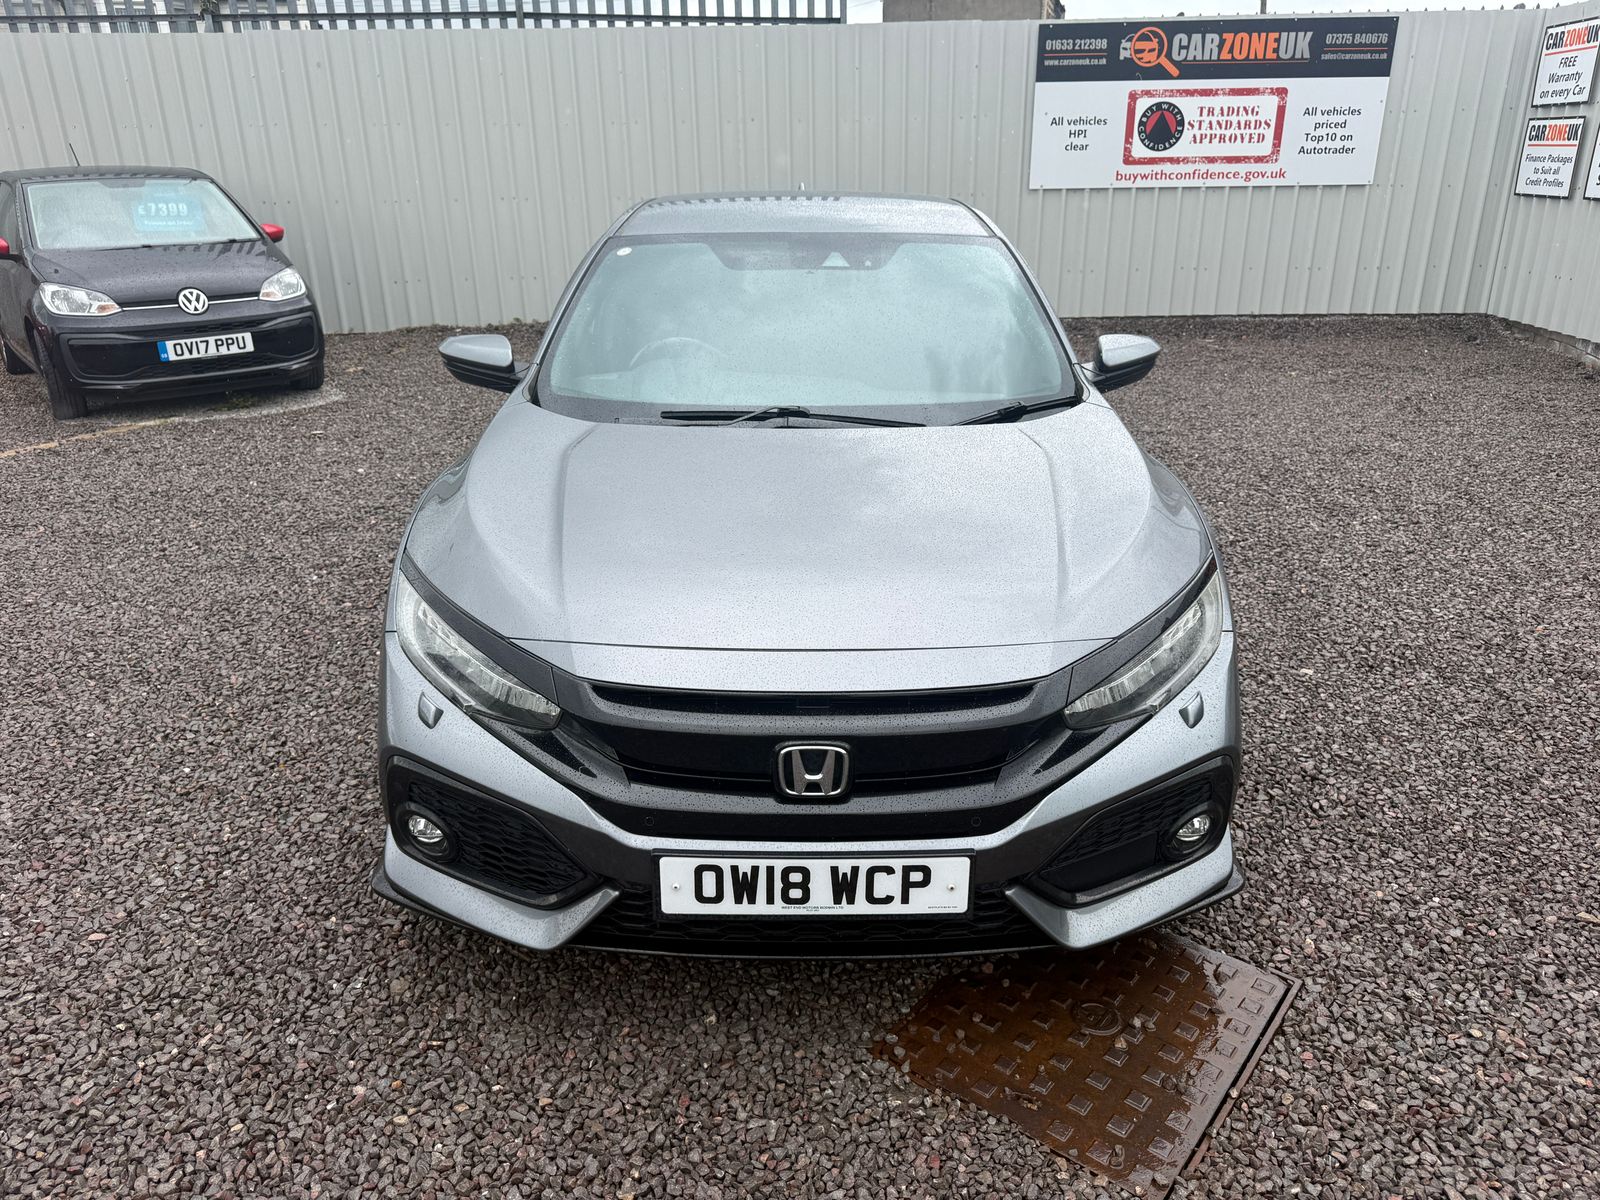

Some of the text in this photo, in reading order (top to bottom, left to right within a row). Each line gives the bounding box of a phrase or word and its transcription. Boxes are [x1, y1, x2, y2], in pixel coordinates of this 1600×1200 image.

[1325, 32, 1389, 45] 07375 840676
[1545, 23, 1600, 51] CARZONEUK
[1045, 38, 1108, 50] 01633 212398
[1171, 31, 1314, 61] CARZONEUK
[1044, 58, 1107, 66] www.carzoneuk.co.uk
[1321, 52, 1388, 60] sales@carzoneuk.co.uk
[1559, 55, 1579, 68] FREE
[1548, 71, 1583, 84] Warranty
[1540, 84, 1586, 100] on every Car
[1141, 103, 1182, 122] BUY WITH
[1197, 105, 1260, 118] TRADING
[1303, 106, 1362, 116] All vehicles
[1050, 116, 1108, 126] All vehicles
[1187, 119, 1272, 131] STANDARDS
[1314, 119, 1347, 131] priced
[1069, 129, 1088, 138] HPI
[1138, 126, 1183, 151] CONFIDENCE
[1189, 132, 1266, 144] APPROVED
[1304, 132, 1353, 144] Top10 on
[1528, 124, 1582, 141] CARZONEUK
[1064, 141, 1089, 151] clear
[1298, 144, 1356, 155] Autotrader
[1525, 154, 1573, 165] Finance Packages
[1115, 168, 1287, 184] buywithconfidence.gov.uk
[1540, 166, 1552, 174] Suit
[1552, 166, 1560, 175] all
[1525, 177, 1564, 187] Credit Profiles
[173, 339, 210, 357] OV17
[214, 336, 246, 352] PPU
[694, 864, 932, 905] OW18 WCP
